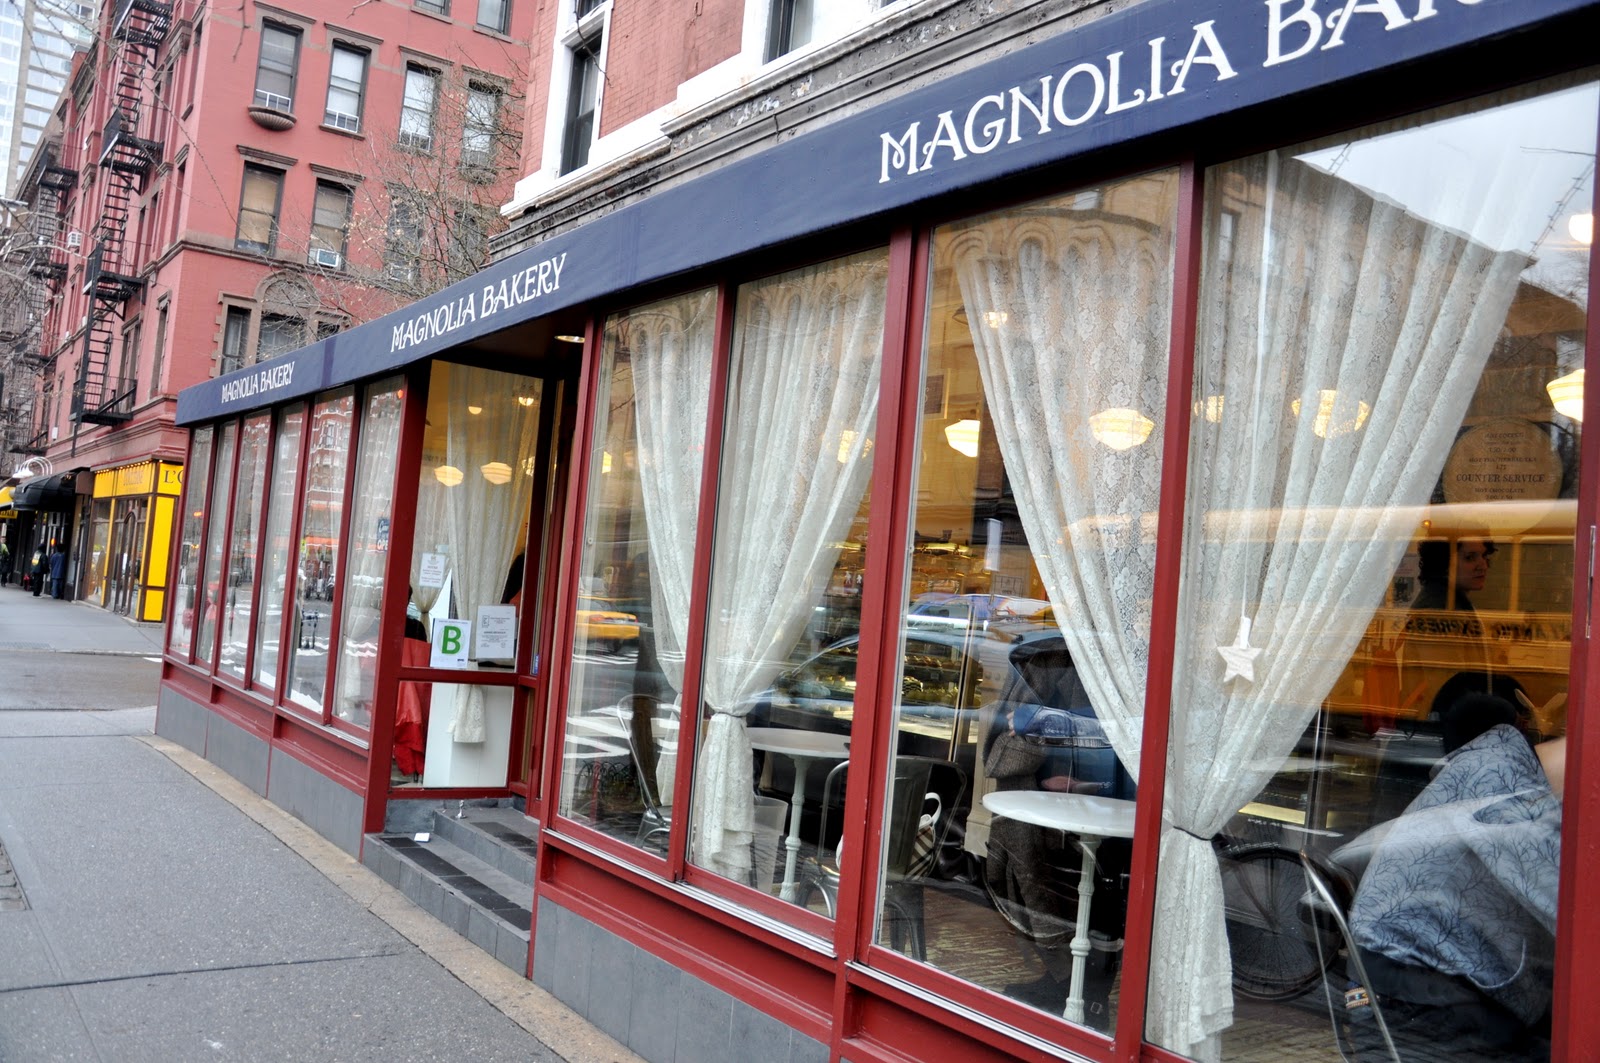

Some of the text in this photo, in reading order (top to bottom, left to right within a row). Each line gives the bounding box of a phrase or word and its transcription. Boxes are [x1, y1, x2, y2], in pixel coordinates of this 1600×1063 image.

[879, 20, 1238, 183] MAGNOLIA
[391, 253, 567, 352] MAGNOLIA BAKERY
[221, 361, 295, 404] MAGNOLIA BAKERY
[1456, 473, 1545, 483] COUNTER SERVICE
[442, 625, 461, 655] B
